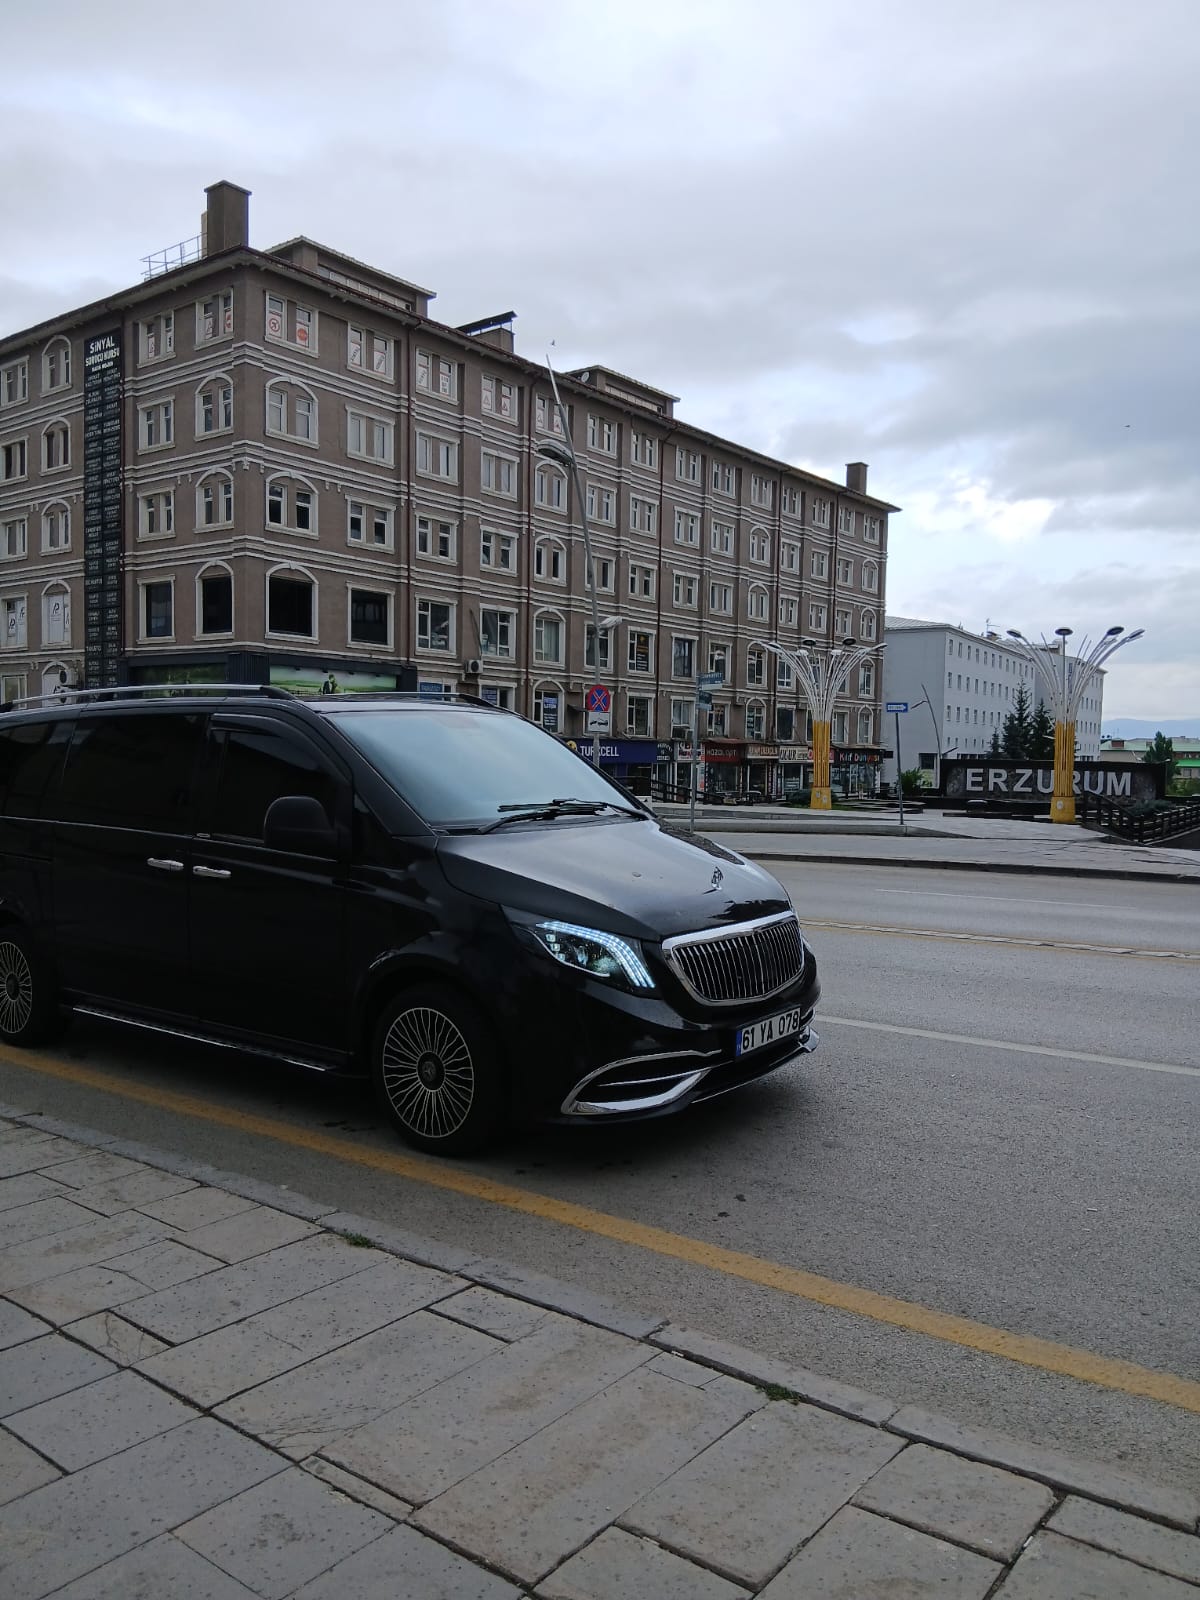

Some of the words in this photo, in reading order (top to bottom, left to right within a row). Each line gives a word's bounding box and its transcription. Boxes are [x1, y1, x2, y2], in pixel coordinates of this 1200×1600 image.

[579, 745, 620, 757] TUCELL
[742, 1027, 755, 1050] 61
[760, 1020, 773, 1043] YA
[779, 1011, 799, 1035] 078
